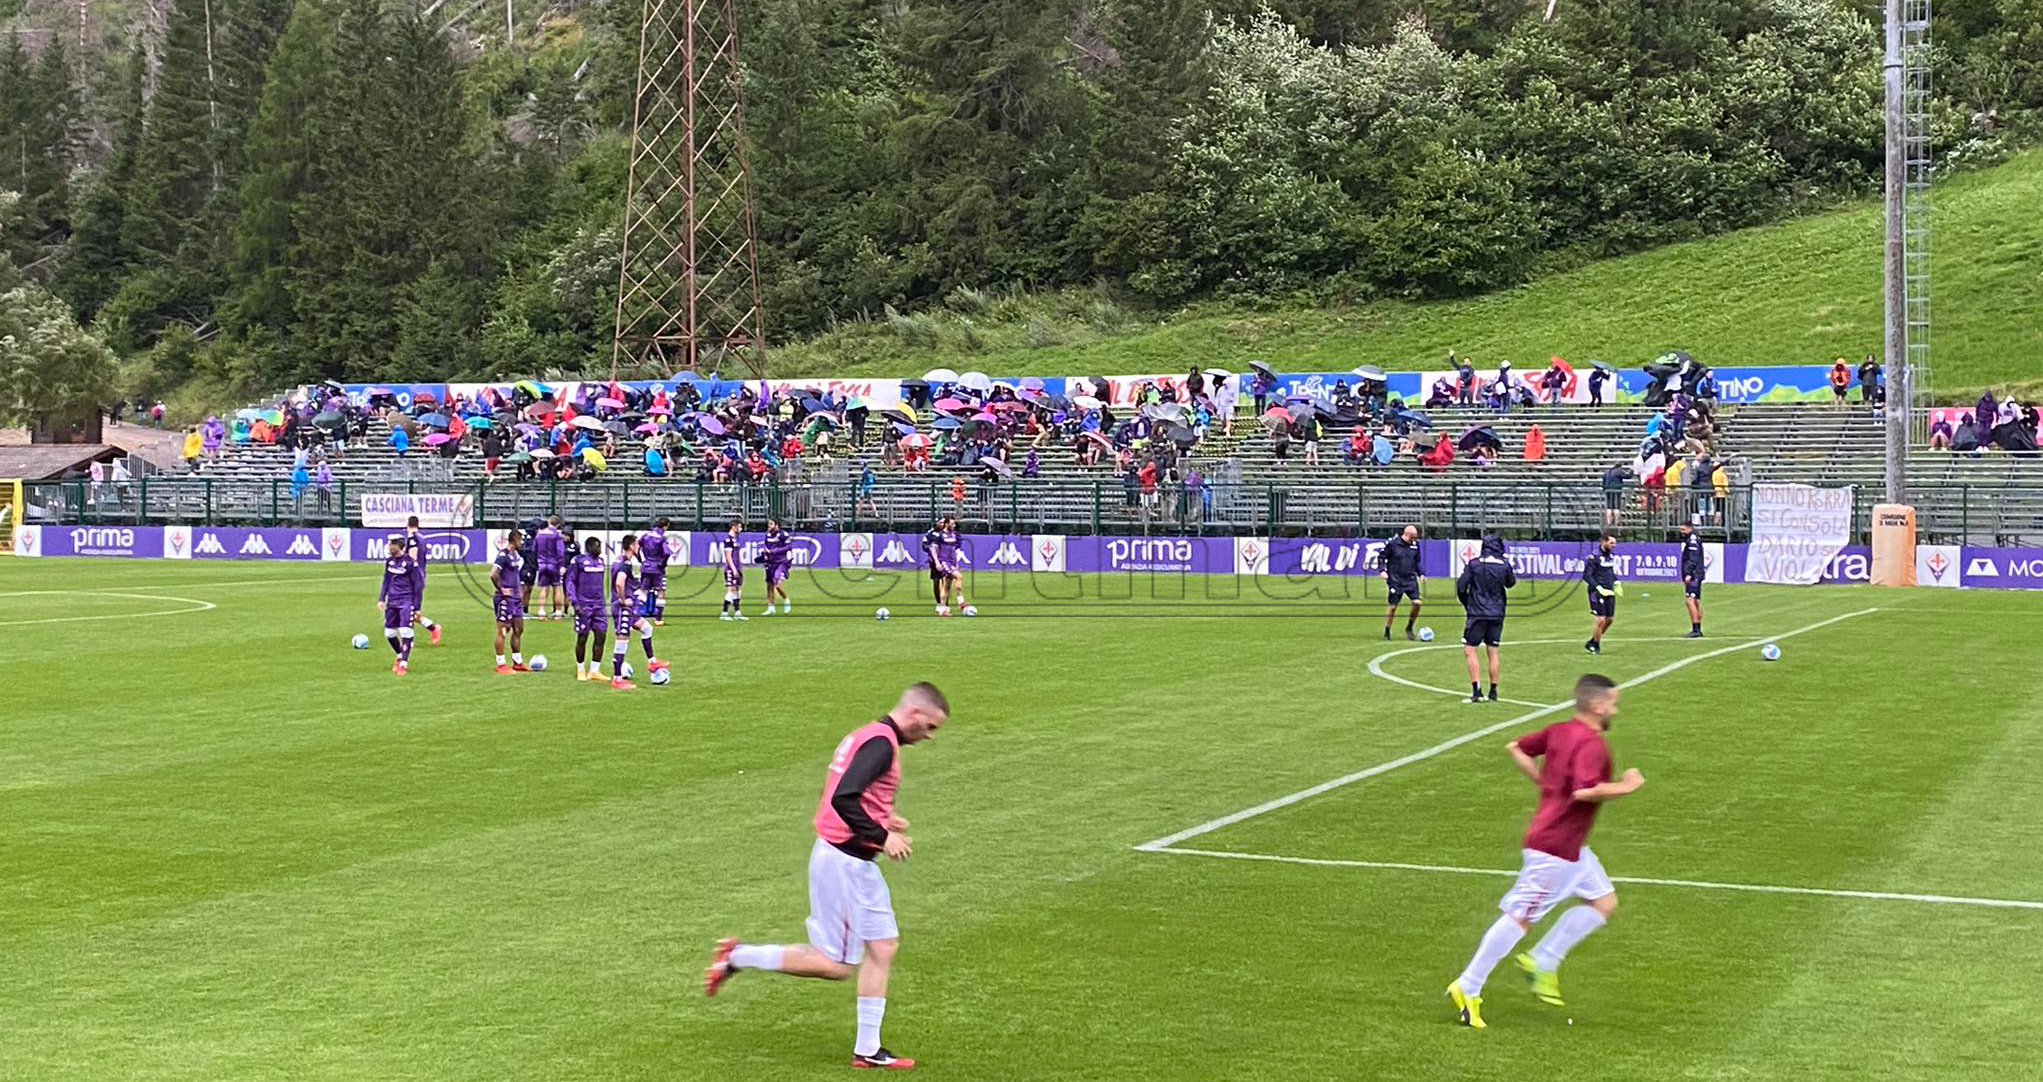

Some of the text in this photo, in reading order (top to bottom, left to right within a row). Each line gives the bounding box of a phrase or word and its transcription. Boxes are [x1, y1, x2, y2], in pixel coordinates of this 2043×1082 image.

[365, 496, 454, 513] CASCIANA TERME
[70, 528, 134, 553] prima
[1107, 539, 1192, 568] prima
[1301, 542, 1332, 573] VAL
